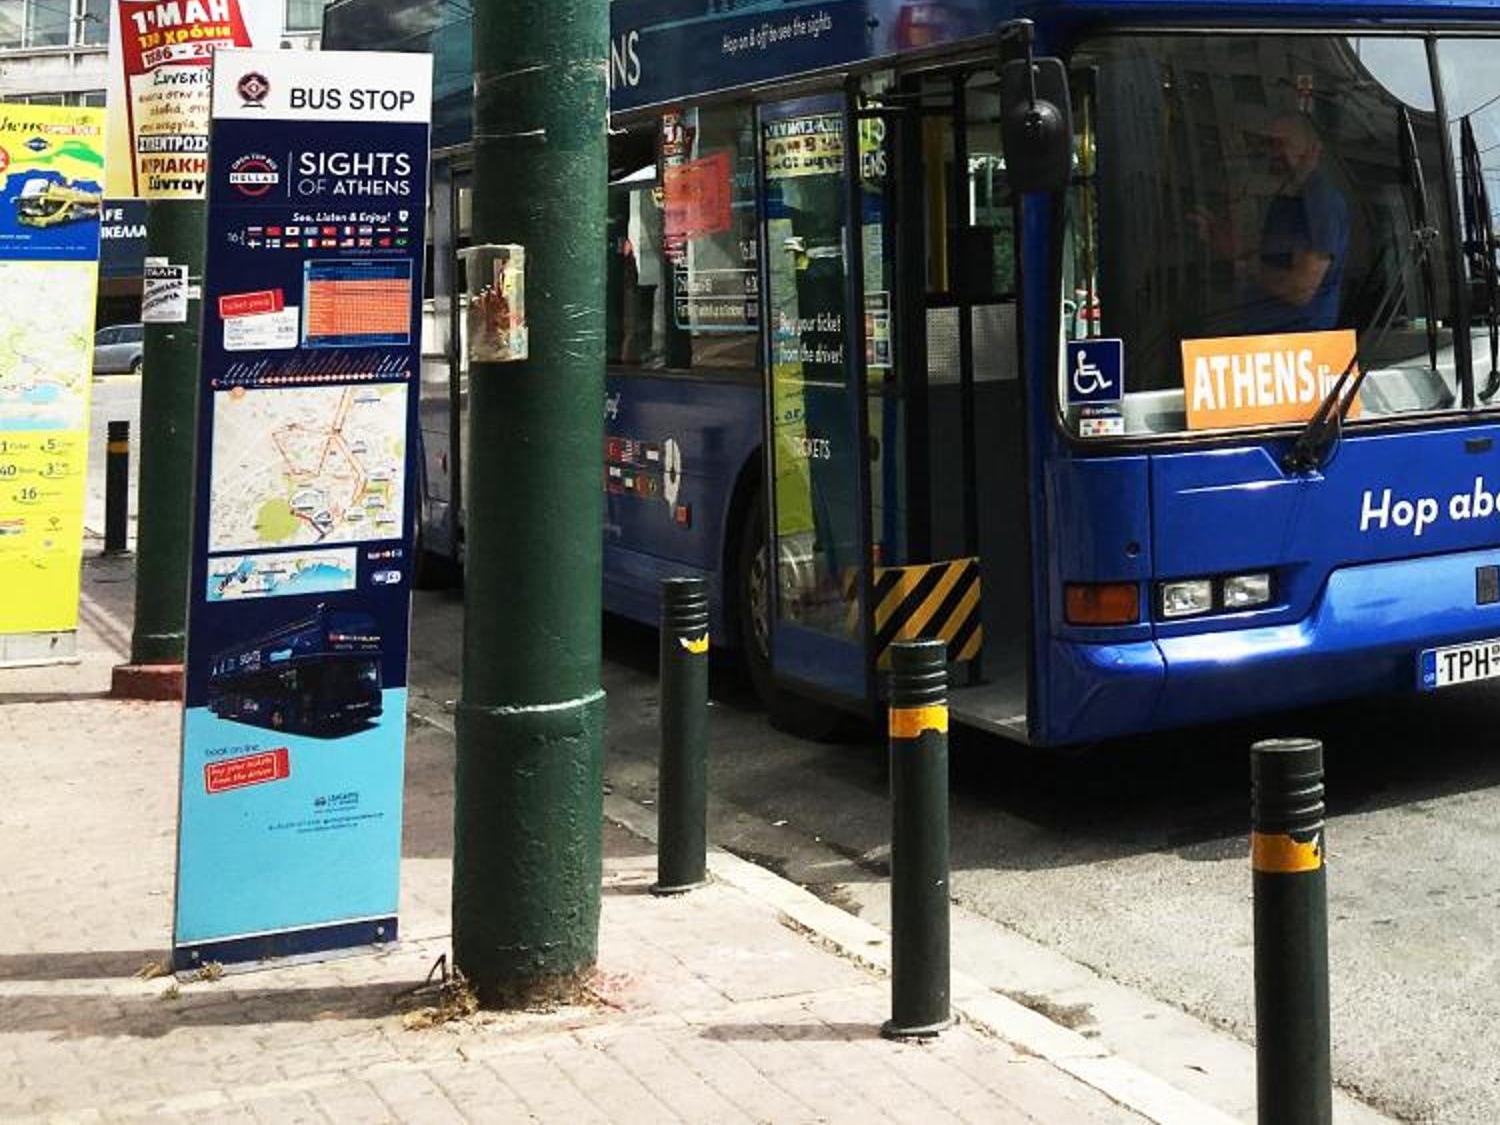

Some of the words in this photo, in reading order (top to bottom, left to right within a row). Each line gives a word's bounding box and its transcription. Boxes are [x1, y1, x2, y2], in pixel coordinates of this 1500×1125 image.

[290, 88, 342, 109] BUS
[350, 89, 415, 111] STOP
[299, 152, 411, 176] SIGHTS
[231, 174, 278, 183] HELLAS
[298, 179, 328, 196] OF
[333, 179, 411, 196] ATHENS
[315, 211, 348, 222] Listen
[349, 212, 358, 222] &
[359, 212, 391, 224] Enjoy!
[1193, 348, 1315, 412] ATHENS
[21, 487, 37, 500] 16
[1360, 489, 1439, 536] Hop
